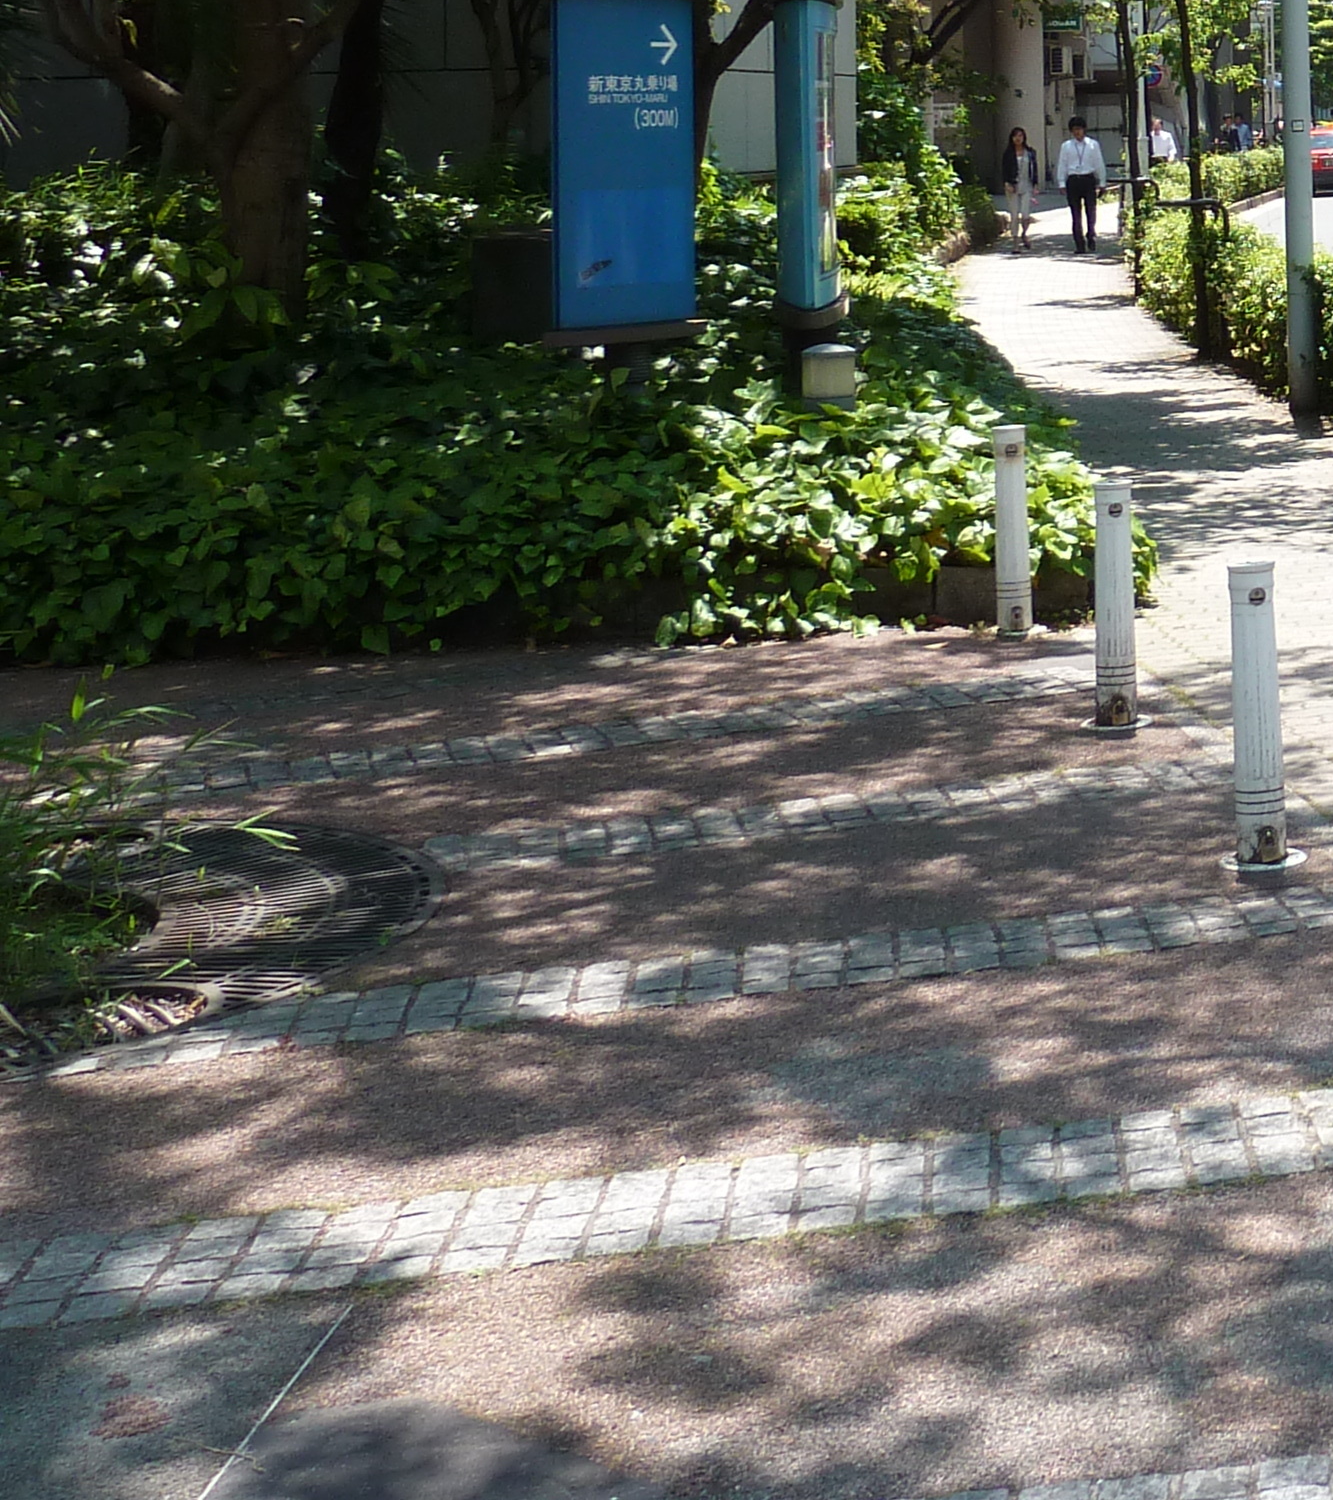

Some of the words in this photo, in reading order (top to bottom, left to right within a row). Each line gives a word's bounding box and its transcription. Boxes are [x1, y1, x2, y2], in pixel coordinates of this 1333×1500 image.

[587, 75, 678, 93] 新東京丸乗り場
[634, 107, 679, 130] (300M)
